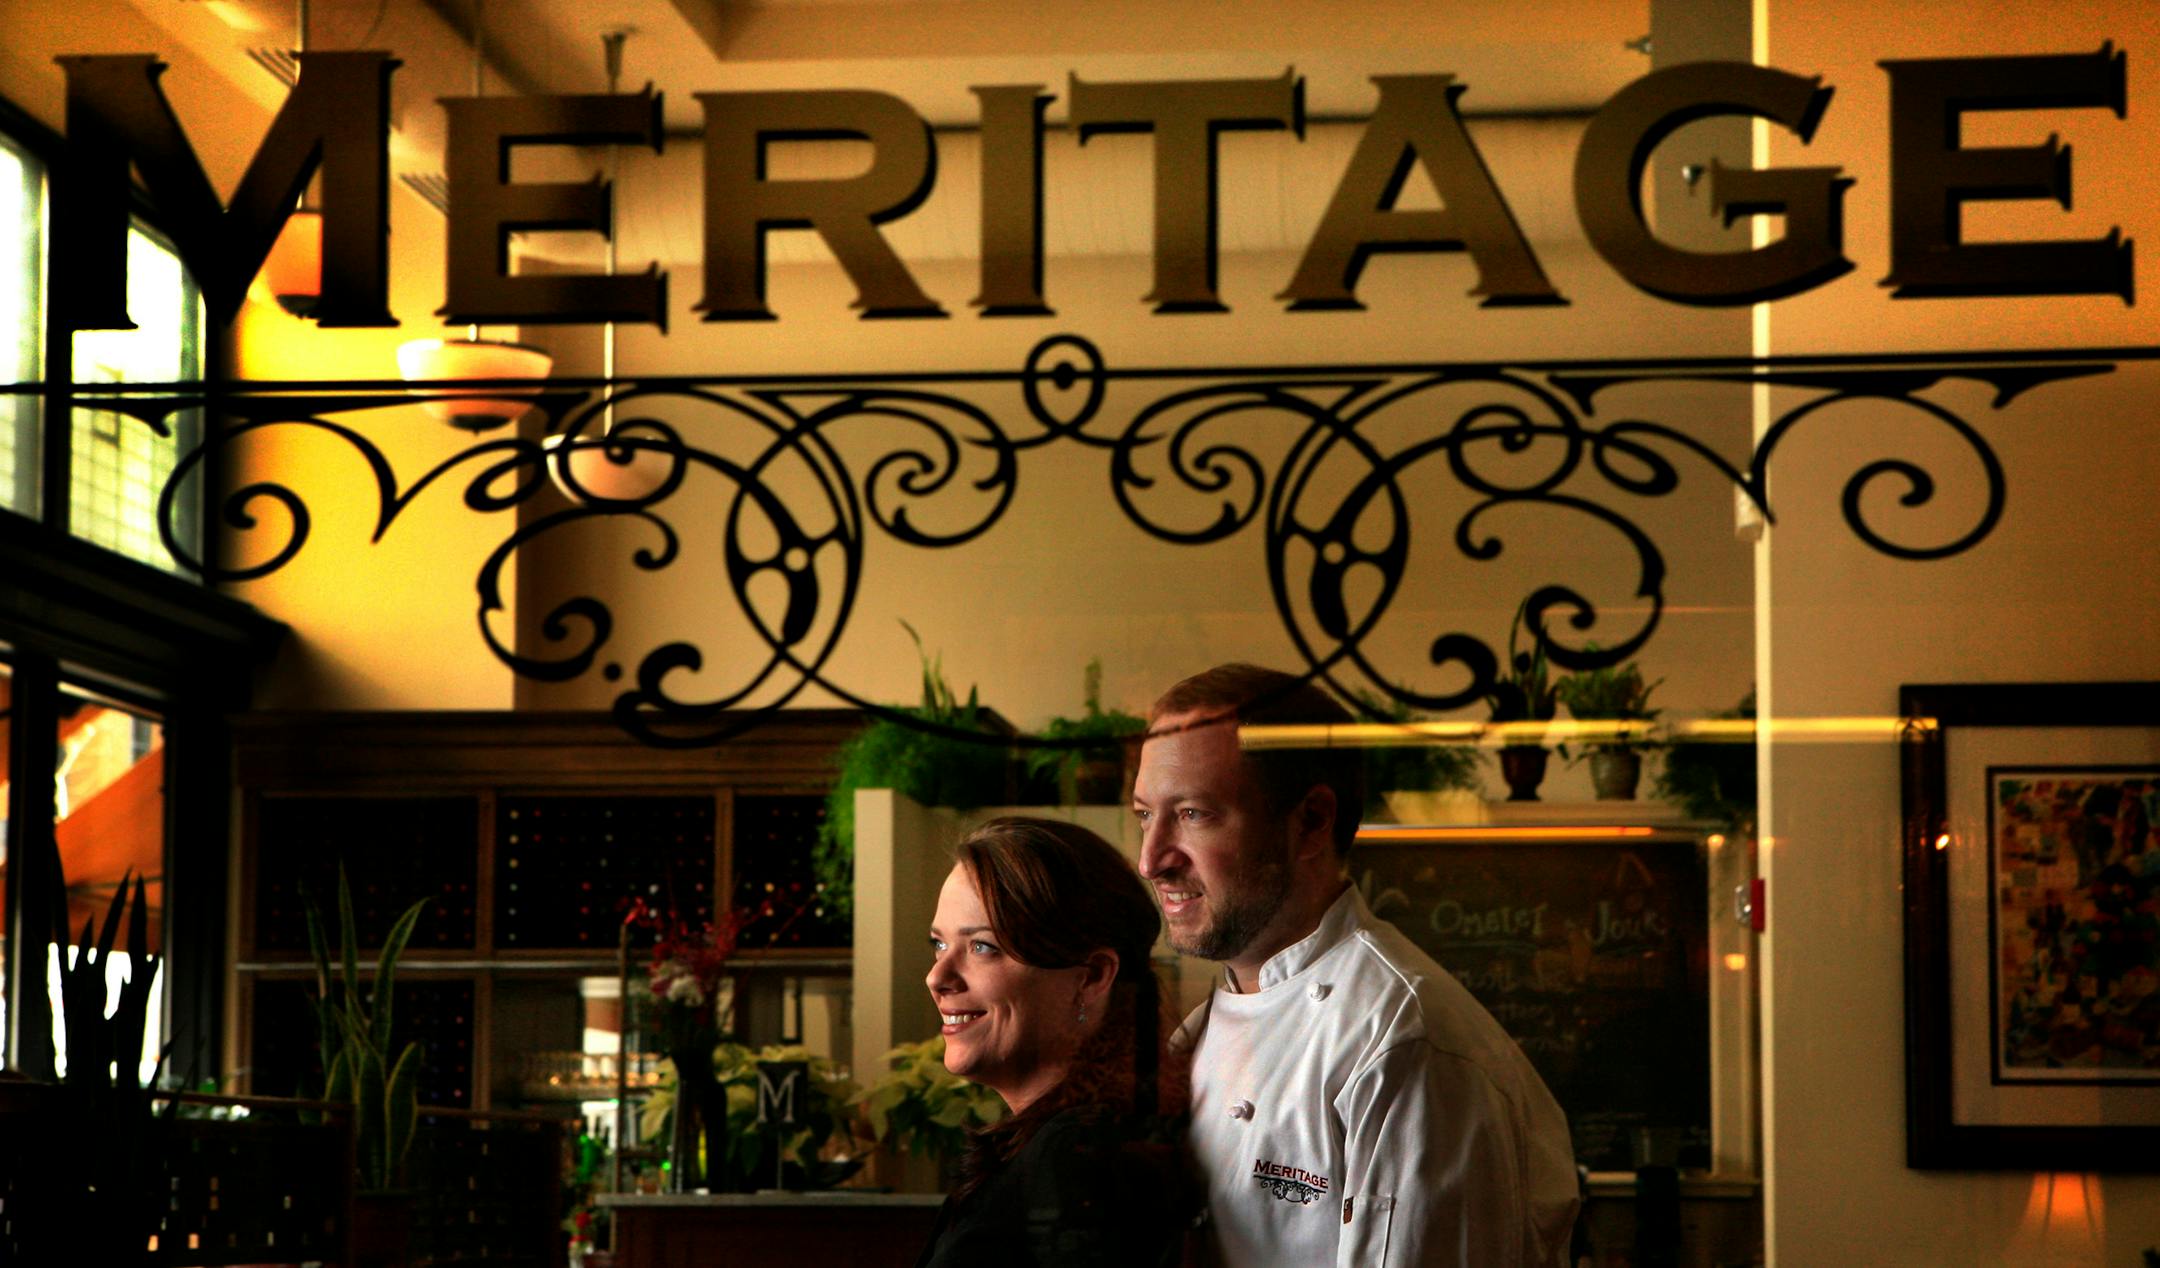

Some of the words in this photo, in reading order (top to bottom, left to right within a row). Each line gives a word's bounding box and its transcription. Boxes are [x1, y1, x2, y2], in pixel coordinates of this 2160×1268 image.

[54, 40, 2134, 335] MERITAGE
[756, 1069, 800, 1123] M
[1253, 1159, 1329, 1189] MERITAGE
